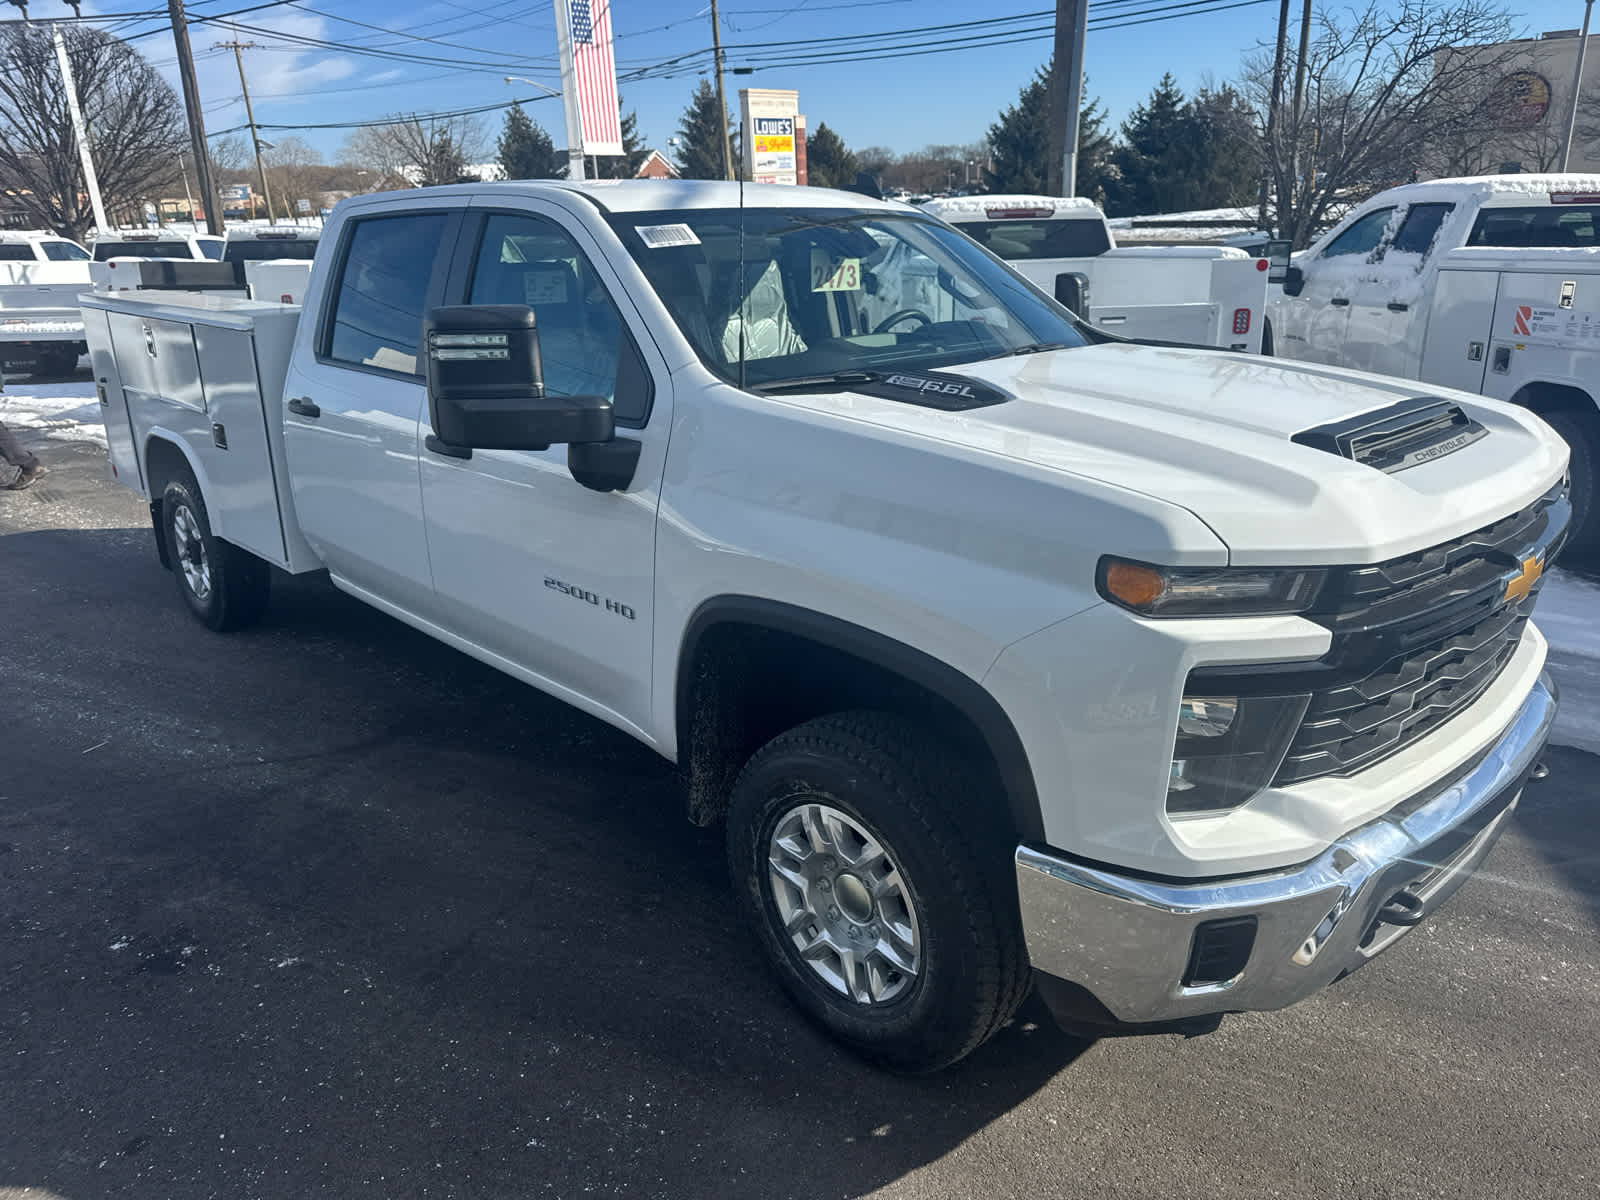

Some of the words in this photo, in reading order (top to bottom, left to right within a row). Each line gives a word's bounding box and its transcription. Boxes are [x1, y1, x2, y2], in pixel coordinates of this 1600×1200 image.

[754, 118, 792, 135] LOWE'S
[1414, 436, 1467, 461] CHEVROLET
[543, 576, 600, 606] 2500
[605, 597, 636, 621] HD
